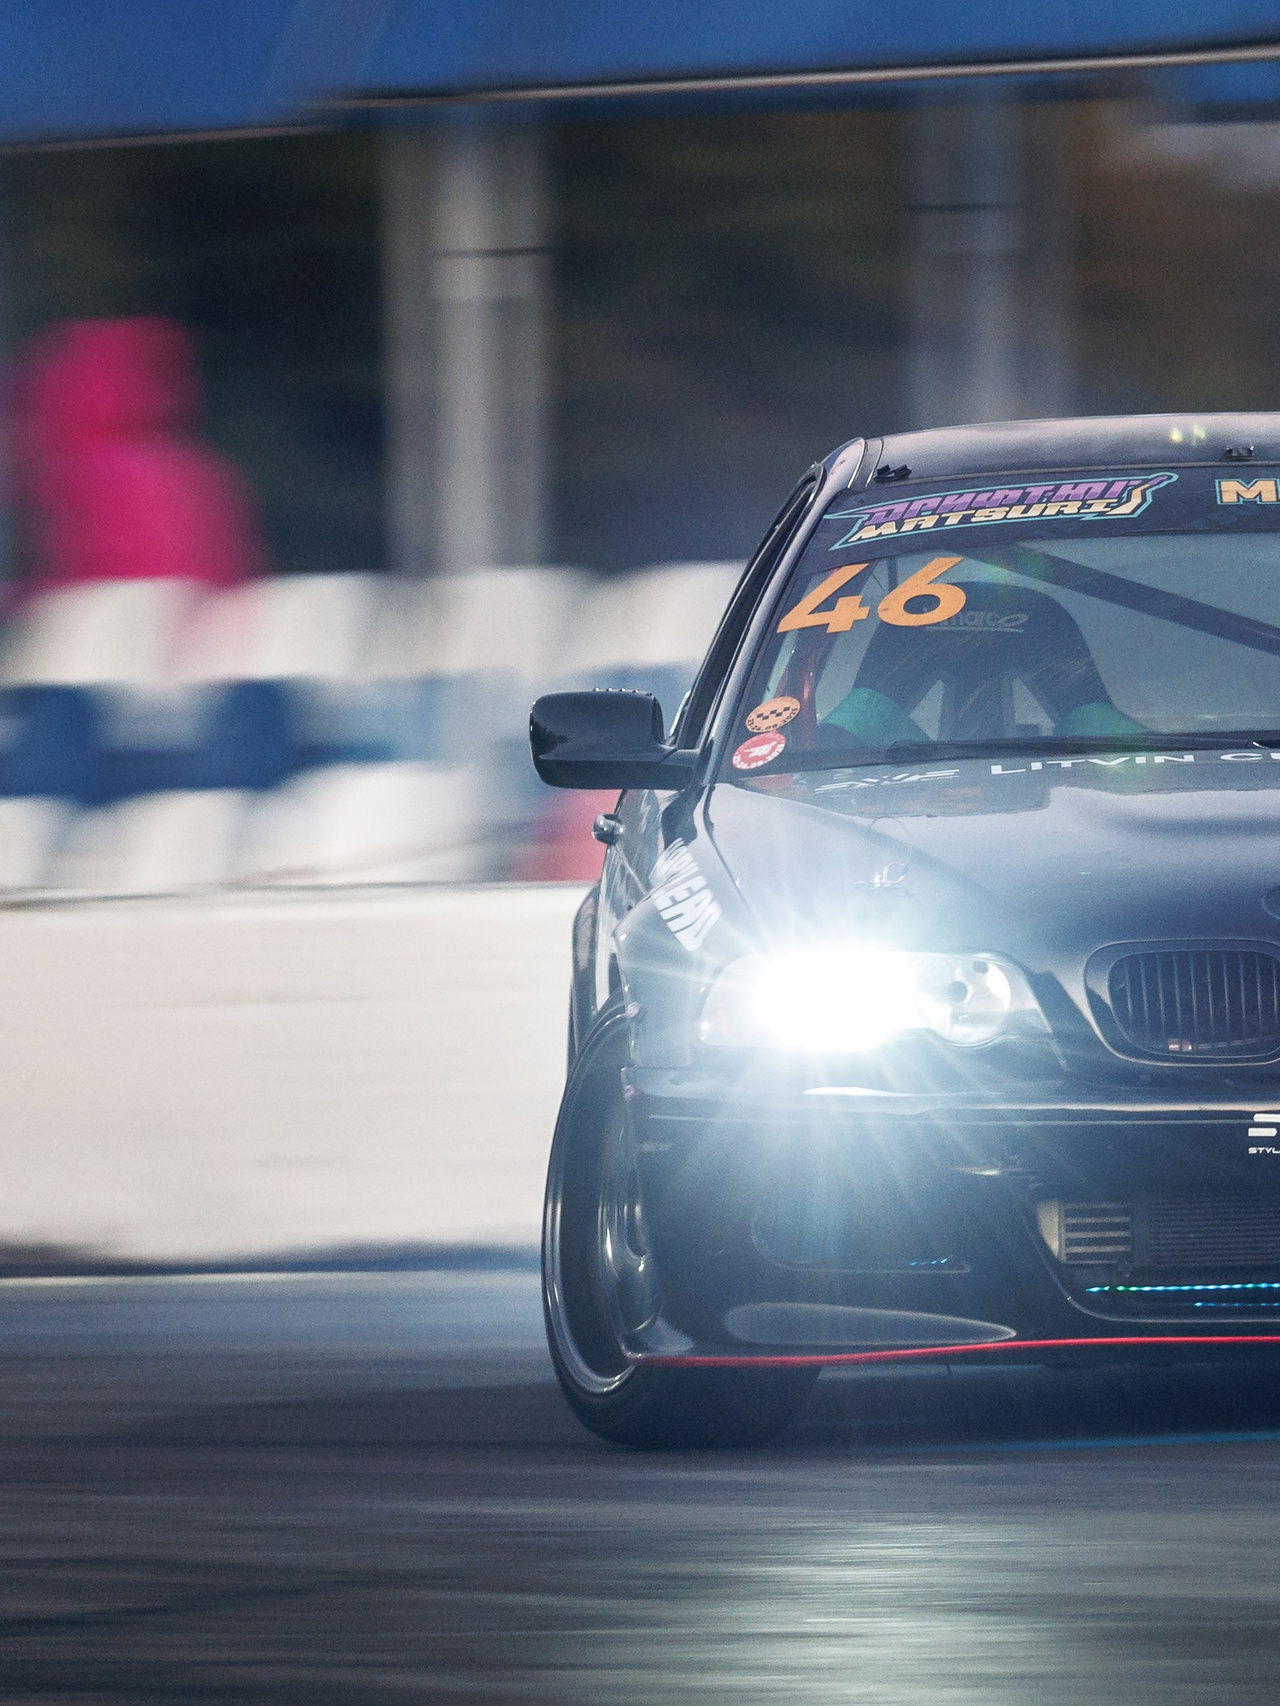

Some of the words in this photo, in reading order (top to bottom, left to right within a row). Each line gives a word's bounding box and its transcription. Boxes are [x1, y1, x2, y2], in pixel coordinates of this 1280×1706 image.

[847, 498, 1118, 542] MATSURI
[776, 557, 967, 634] 46
[990, 754, 1195, 775] LITVIN
